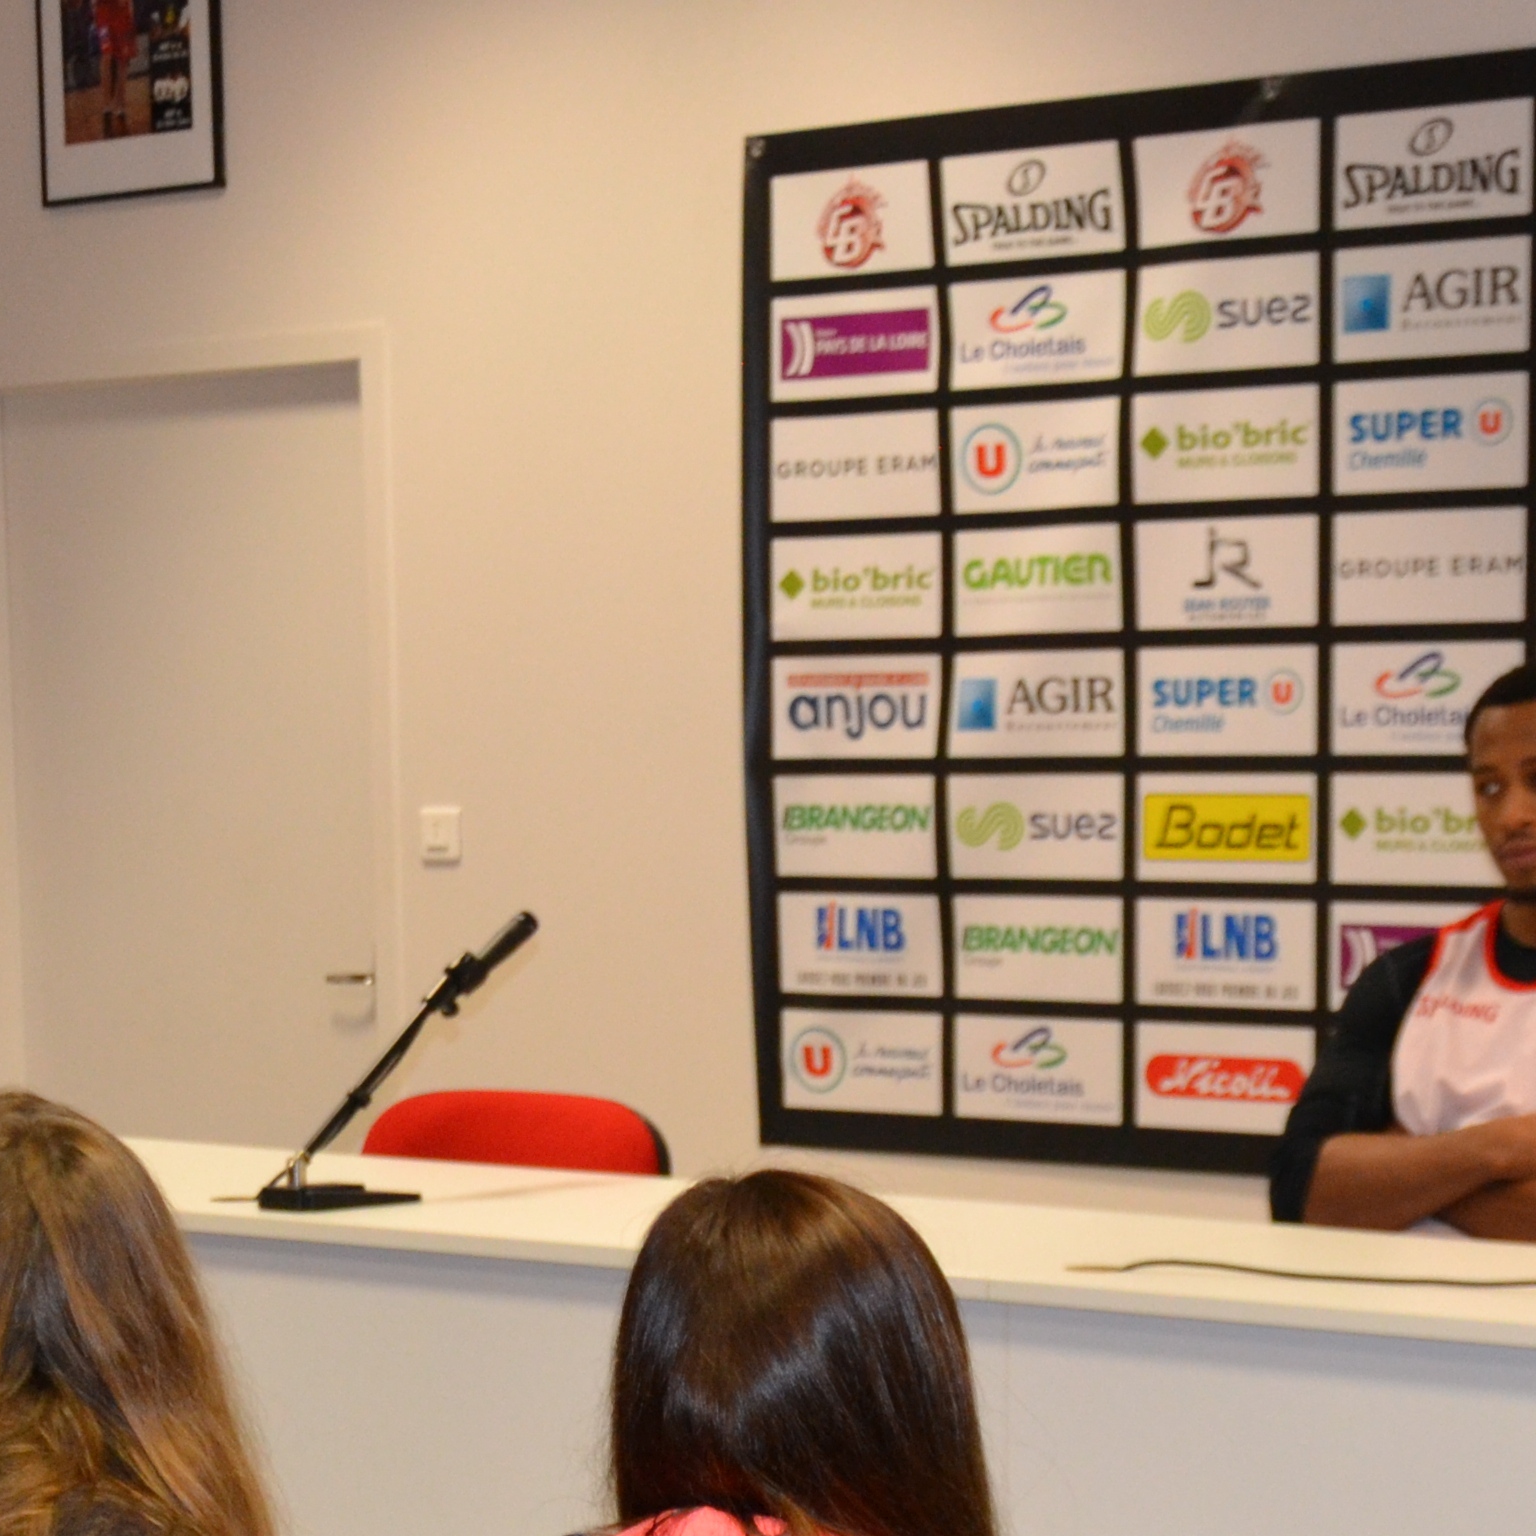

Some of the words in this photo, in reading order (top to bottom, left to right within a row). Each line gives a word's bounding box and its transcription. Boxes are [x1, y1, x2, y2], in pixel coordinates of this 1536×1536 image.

[1342, 146, 1522, 209] SPALDING
[951, 189, 1113, 246] SPALDING
[1401, 265, 1523, 314] AGIR
[1215, 293, 1312, 330] suez
[960, 343, 985, 364] Le
[990, 336, 1087, 360] Choletais
[1348, 408, 1463, 444] SUPER
[1478, 408, 1504, 436] U
[775, 454, 868, 481] GROUPE
[876, 450, 938, 476] ERAM
[975, 441, 1005, 478] U
[962, 550, 1113, 591] GAUTIER
[1338, 555, 1441, 580] GROUPE
[1450, 551, 1525, 578] ERAM
[1005, 675, 1119, 716] AGIR
[1152, 676, 1258, 707] SUPER
[1272, 679, 1294, 704] U
[787, 688, 929, 740] anjou
[1339, 706, 1369, 728] Le
[1375, 703, 1465, 728] Choleta
[781, 804, 932, 833] BRANGEON
[1029, 808, 1118, 842] suez
[1154, 803, 1302, 851] Bodet
[838, 906, 907, 953] LNB
[962, 921, 1120, 957] BRANGEON
[1200, 913, 1279, 961] LNB
[801, 1044, 833, 1076] U
[1158, 1056, 1293, 1100] Nicoll
[963, 1072, 991, 1093] Le
[996, 1070, 1085, 1098] Choletais
